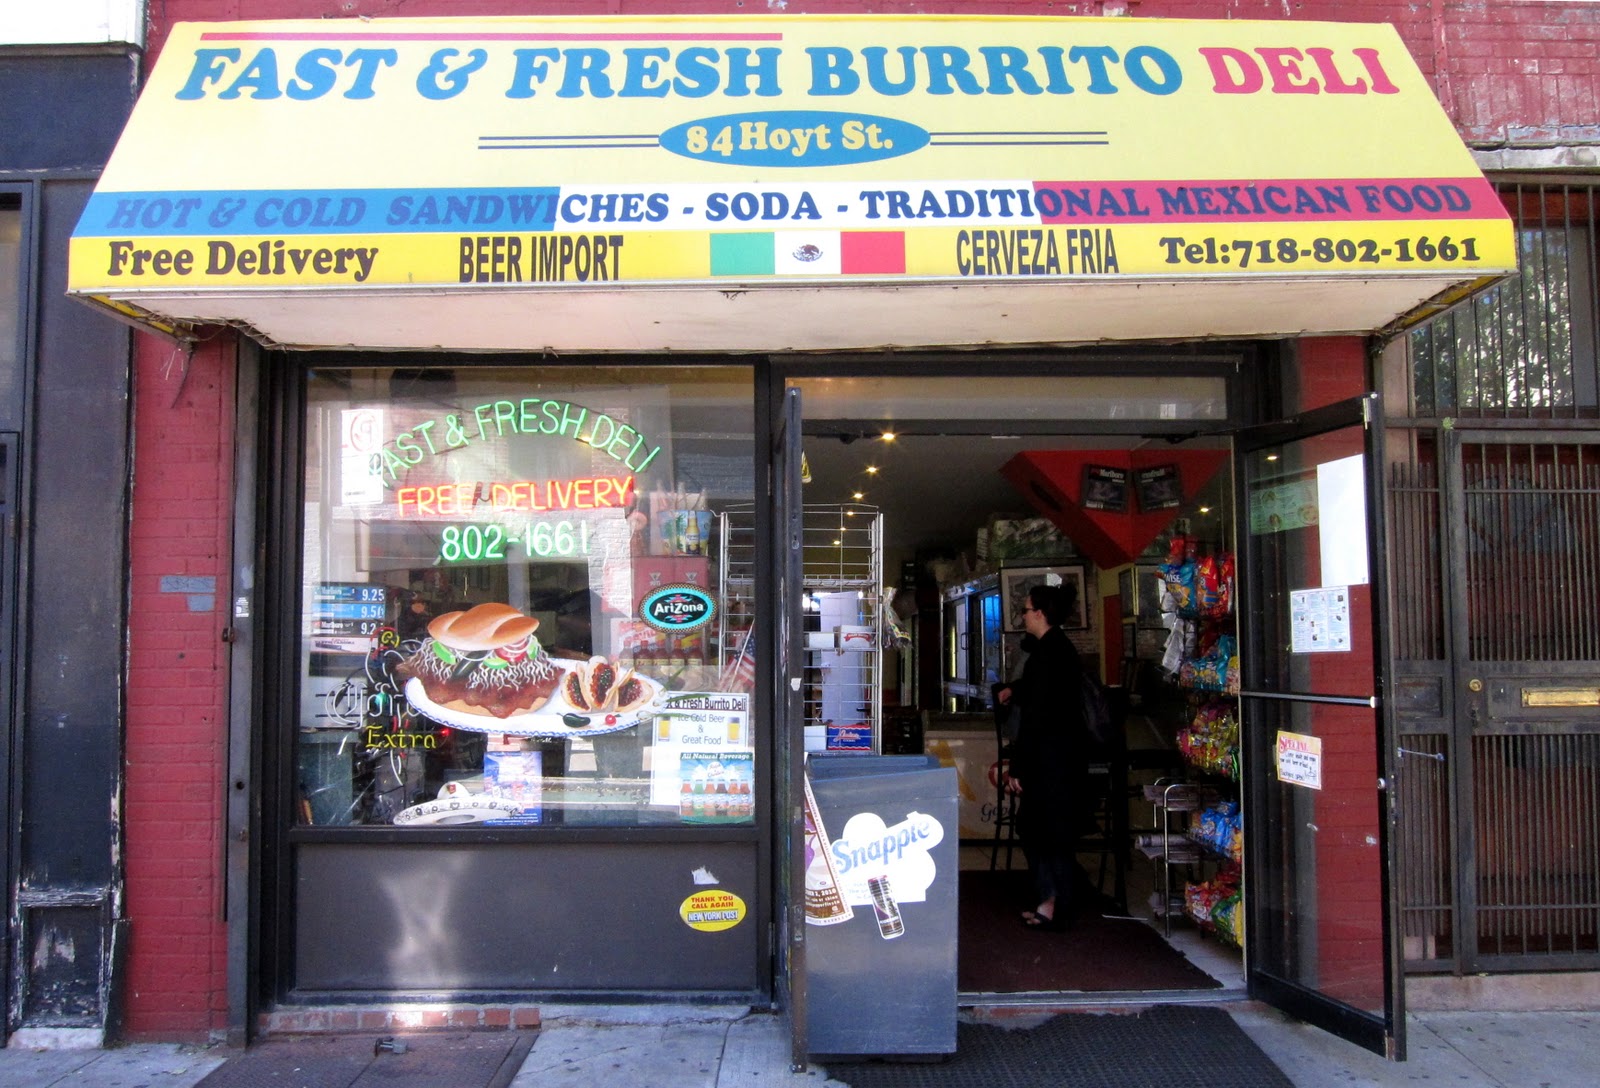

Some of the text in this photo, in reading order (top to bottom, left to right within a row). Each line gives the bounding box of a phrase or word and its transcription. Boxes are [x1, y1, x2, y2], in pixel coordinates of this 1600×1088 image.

[175, 45, 1400, 100] FAST & FRESH BURRITO DELI
[685, 120, 894, 157] 84 Hoyt St.
[107, 198, 194, 229] HOT
[207, 198, 247, 229] &
[256, 197, 366, 228] COLD
[386, 192, 670, 227] SANDWICHES
[706, 192, 823, 222] SODA
[860, 187, 1153, 220] TRADITIONAL
[1159, 185, 1351, 216] MEXICAN
[1360, 184, 1473, 214] FOOD
[107, 239, 378, 284] Free Delivery
[460, 234, 624, 283] BEER IMPORT
[956, 228, 1119, 277] CERVEZA FRIA
[369, 398, 661, 488] AST & FRESH DELI
[397, 477, 633, 517] FREE DELIVERY
[441, 520, 589, 561] 802-1661
[362, 588, 385, 602] 9.25
[654, 602, 704, 616] AriZona
[361, 622, 378, 635] 9.2
[682, 698, 703, 709] Fresh
[705, 697, 729, 710] Burrito
[733, 697, 746, 711] Deli
[709, 713, 725, 723] Beer
[366, 725, 436, 748] Extra
[682, 735, 722, 745] Great Food
[698, 724, 704, 734] &
[688, 910, 738, 922] NEW YORK POST
